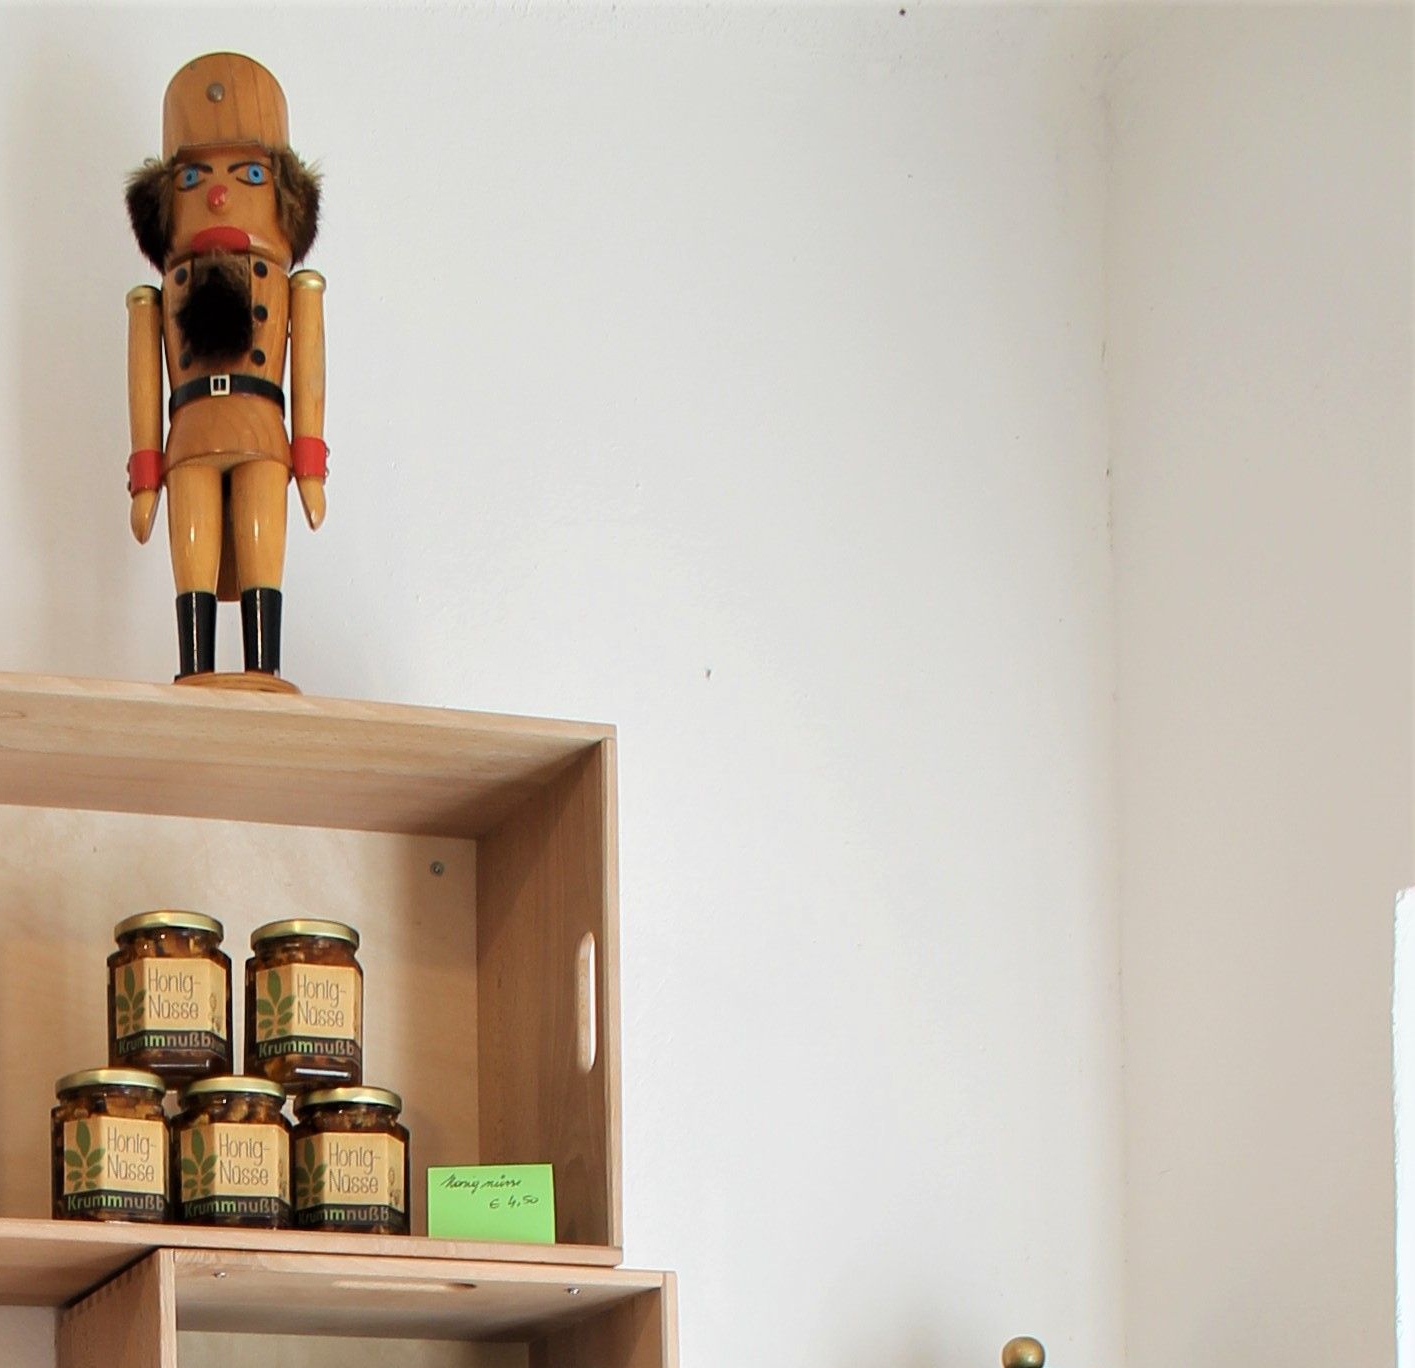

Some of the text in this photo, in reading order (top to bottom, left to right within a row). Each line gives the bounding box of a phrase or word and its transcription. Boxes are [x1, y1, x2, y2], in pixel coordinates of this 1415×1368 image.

[148, 966, 201, 998] Honig-
[296, 972, 347, 1007] Honig-
[148, 995, 199, 1020] Nüsse
[297, 1000, 344, 1027] Nüsse
[107, 1126, 157, 1157] Honig-
[218, 1132, 271, 1165] Honig-
[107, 1155, 155, 1181] Nüsse
[219, 1161, 269, 1186] Nüsse
[328, 1142, 381, 1176] Honig-
[328, 1170, 378, 1194] Nüsse
